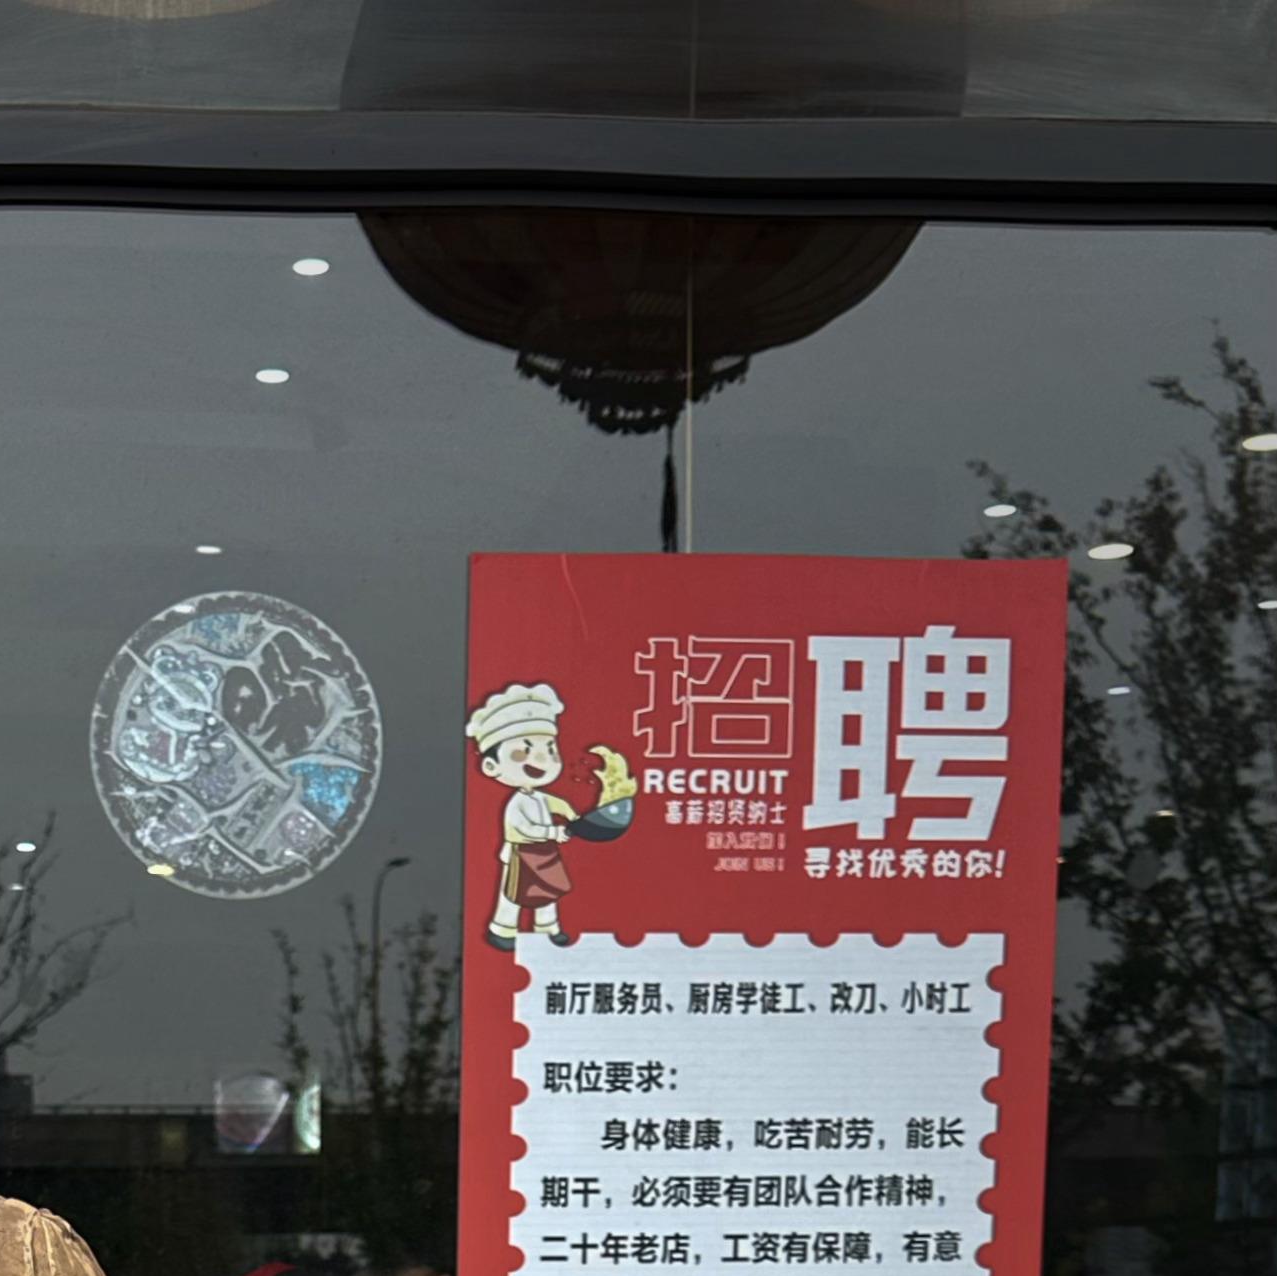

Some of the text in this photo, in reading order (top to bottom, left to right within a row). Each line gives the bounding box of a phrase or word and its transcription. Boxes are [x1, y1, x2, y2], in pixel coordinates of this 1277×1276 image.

[633, 625, 1012, 840] 招聘
[643, 768, 790, 795] RECRUIT
[665, 800, 787, 825] 高薪招贤纳士
[545, 981, 972, 1016] 前厅服务员、厨房学徒工、改刀、小时工
[543, 1061, 680, 1094] 职位要求：
[600, 1118, 965, 1152] 身体健康，吃苦耐劳，能长
[540, 1175, 948, 1209] 期干，必须要有团队合作精神，
[539, 1231, 963, 1266] 二十年老店，工资有保障，有意
